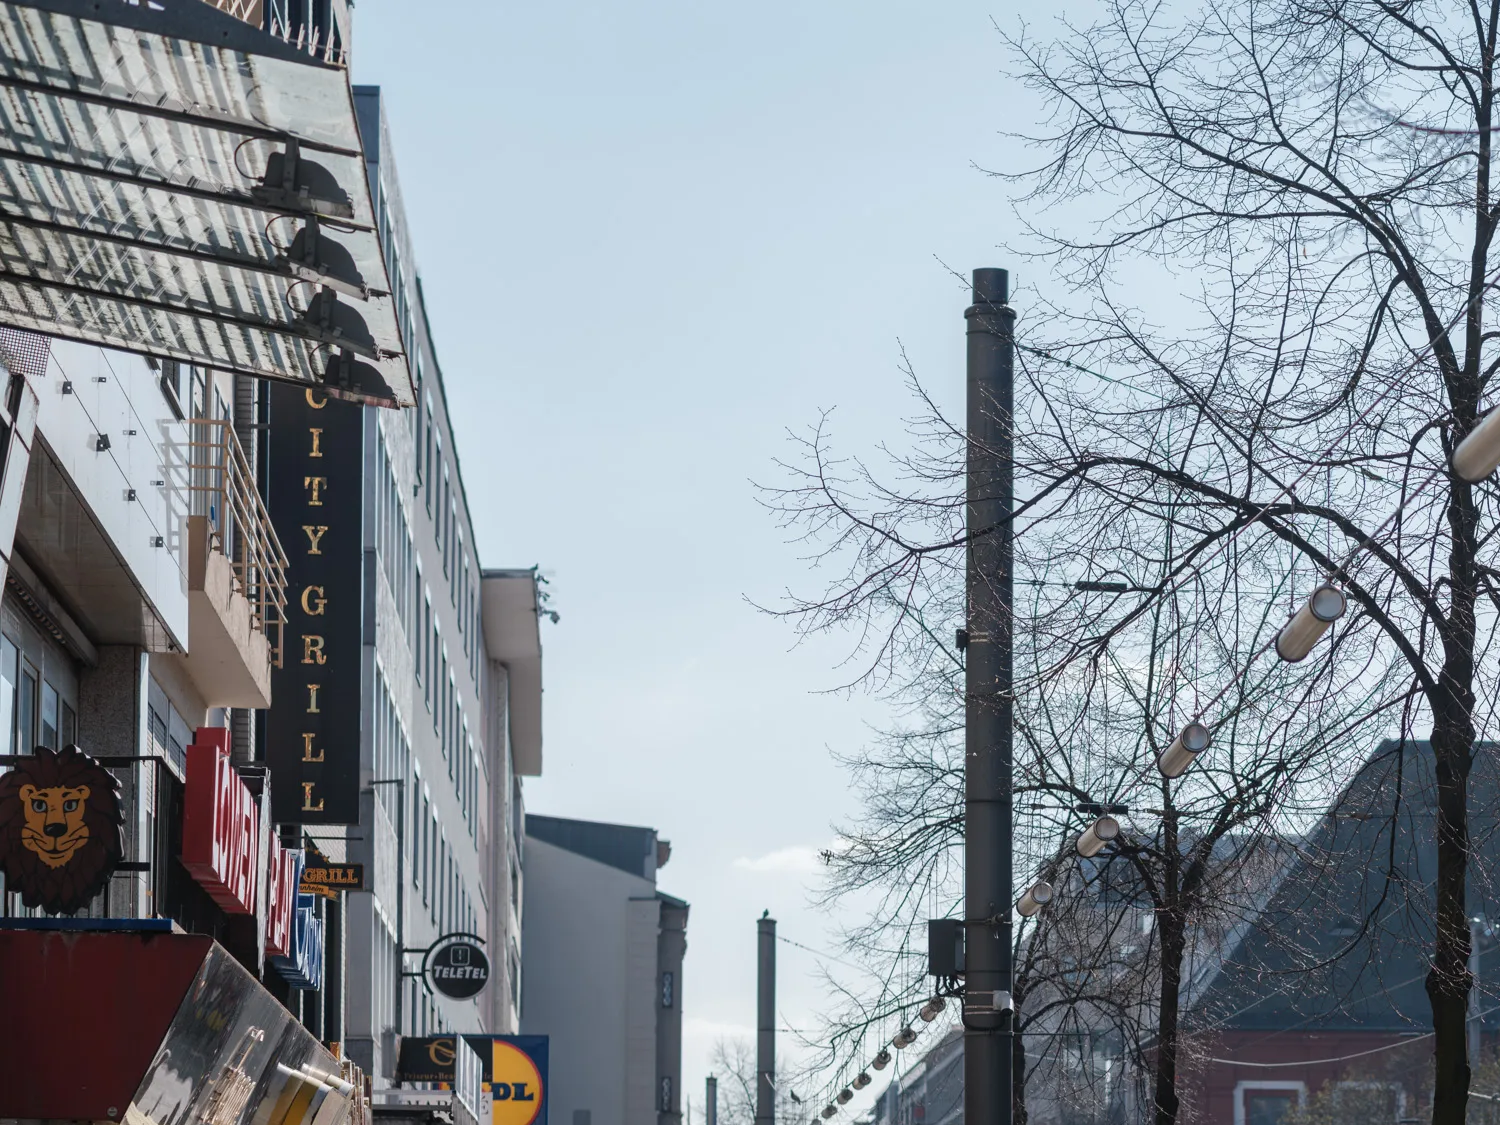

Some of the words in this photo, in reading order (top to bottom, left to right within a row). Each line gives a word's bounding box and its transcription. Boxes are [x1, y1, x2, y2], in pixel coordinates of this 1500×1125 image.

[303, 387, 329, 556] CITY
[300, 584, 328, 812] GRILL
[303, 867, 359, 884] GRILL
[489, 1082, 535, 1102] DL
